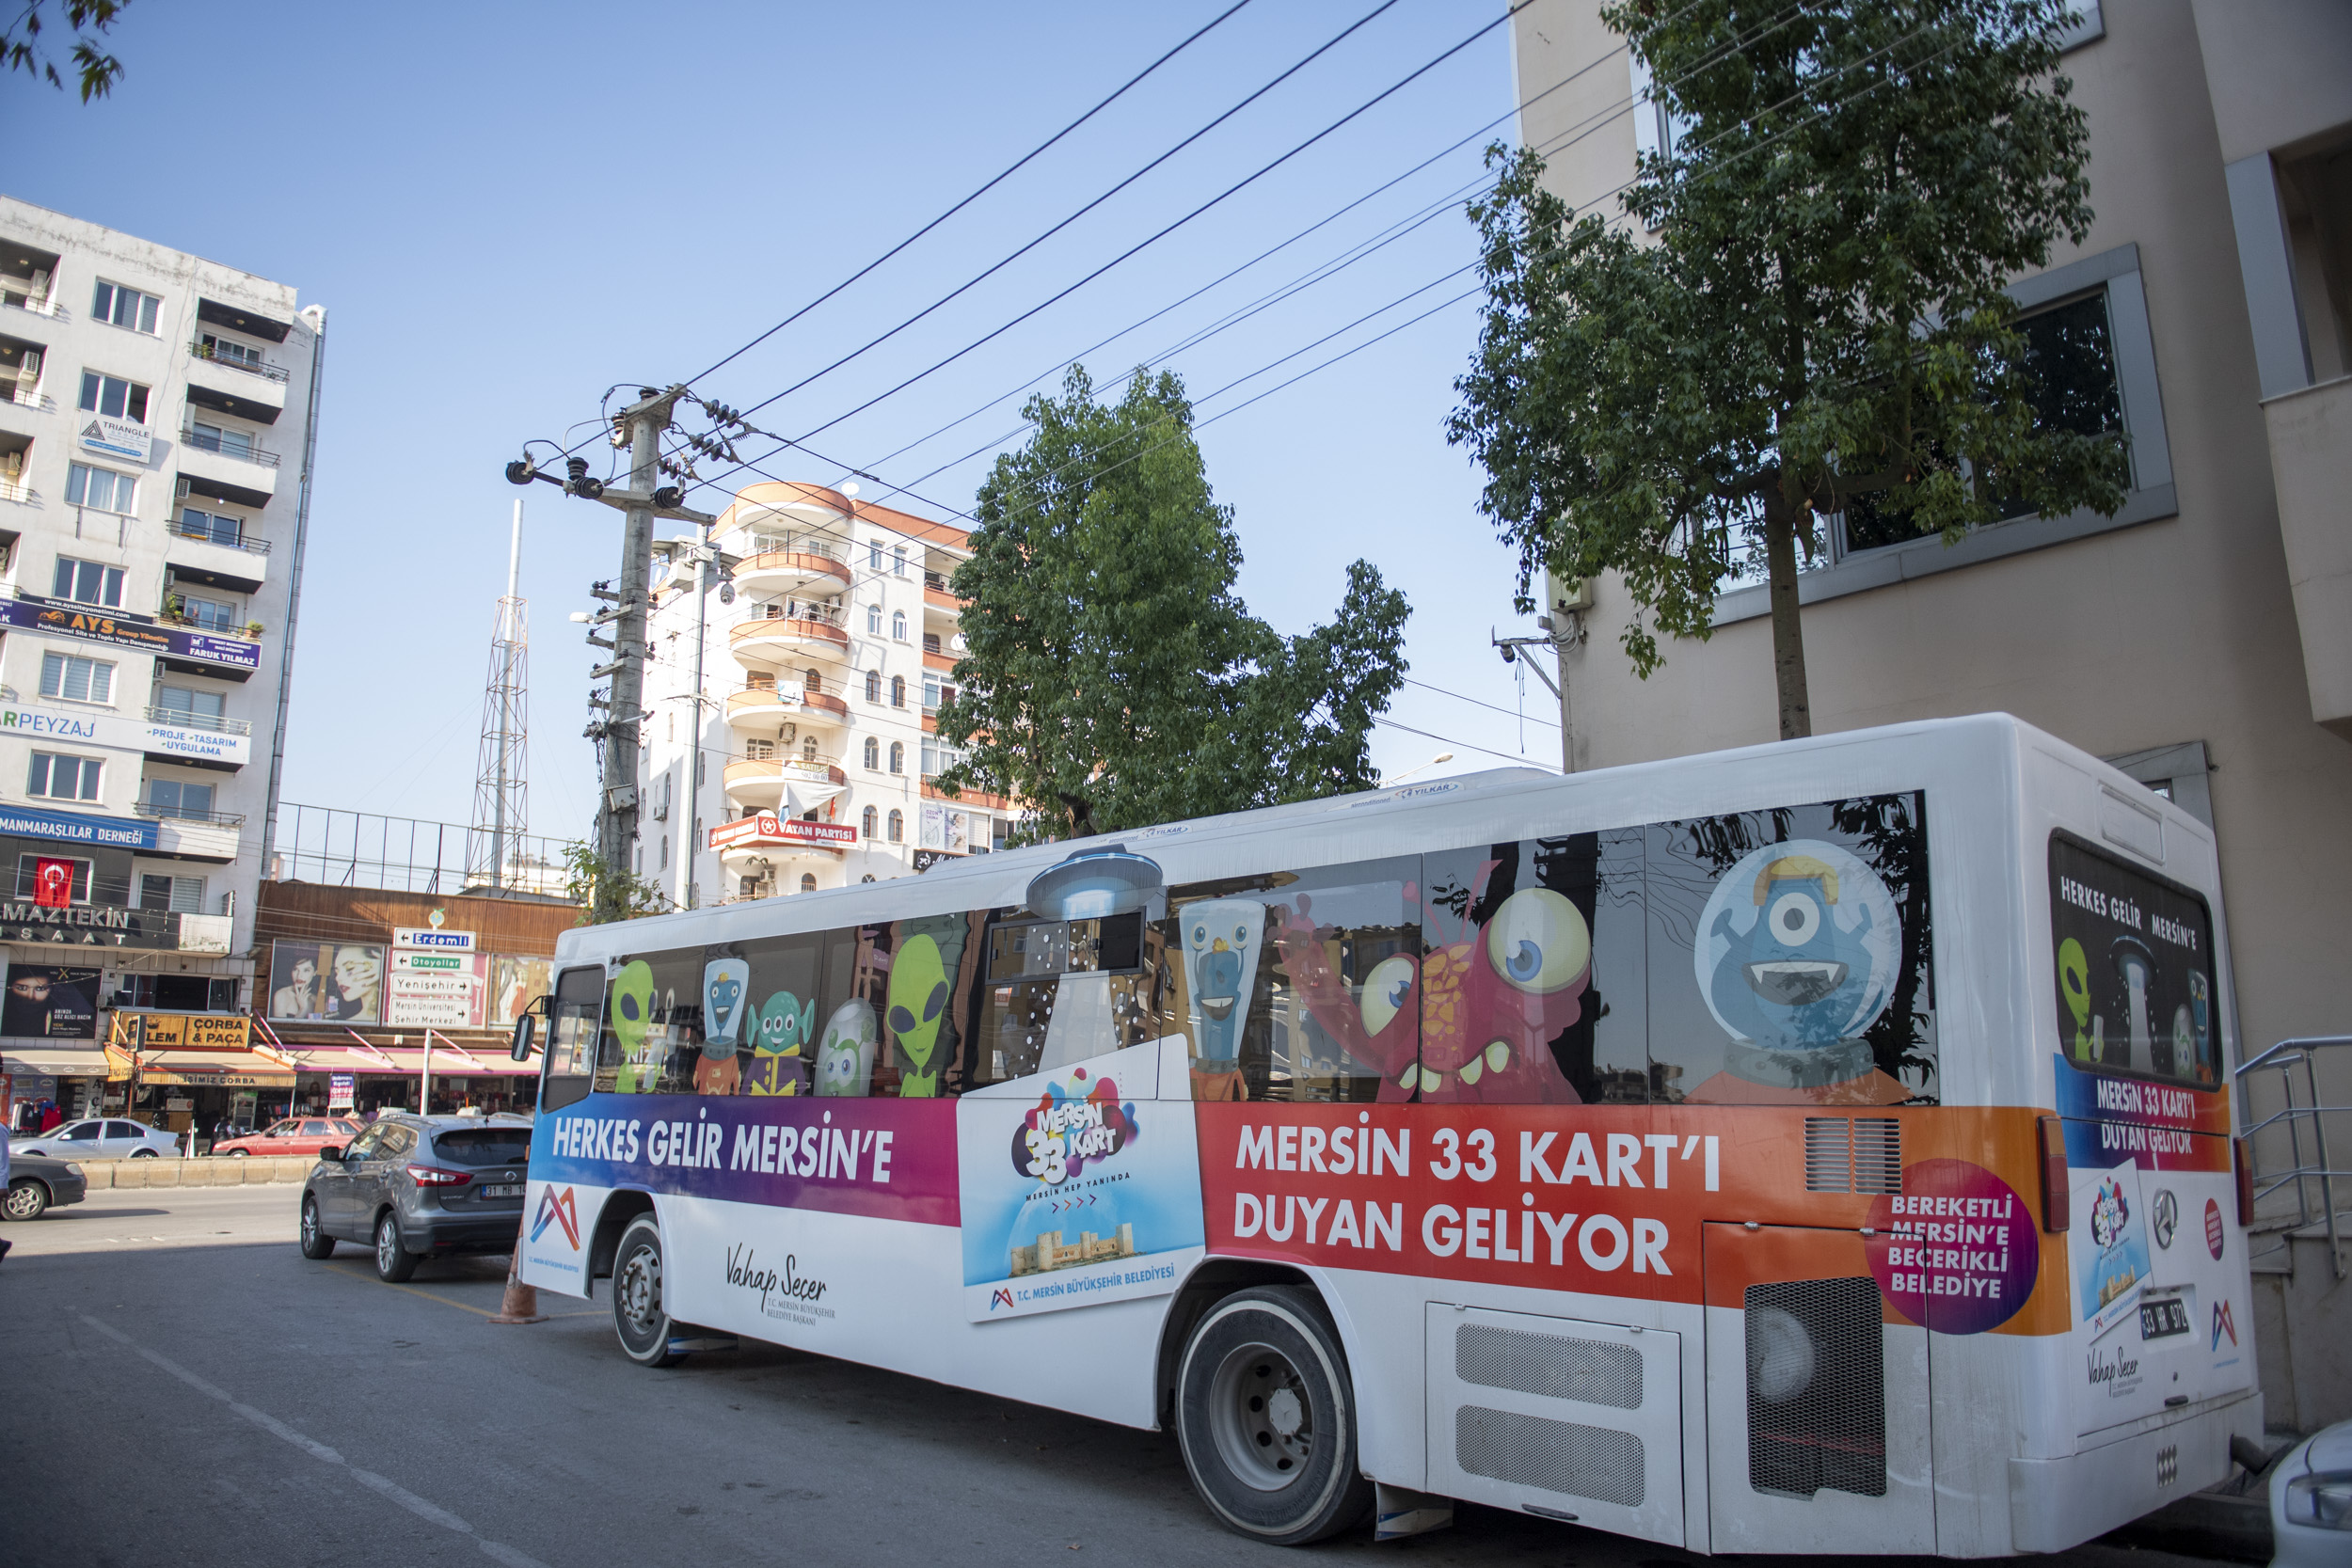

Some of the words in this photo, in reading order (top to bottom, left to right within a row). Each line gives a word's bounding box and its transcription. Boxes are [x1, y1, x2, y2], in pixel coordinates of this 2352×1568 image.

[103, 421, 151, 438] TRIANGLE
[38, 623, 74, 635] Profesyonel
[97, 633, 114, 641] Toplu
[71, 613, 115, 634] AYS
[117, 628, 139, 639] Group
[189, 647, 220, 660] FARUK
[221, 653, 255, 666] YILMAZ
[152, 728, 185, 741] PROJE
[193, 734, 237, 748] TASARIM
[167, 741, 221, 756] UYGULAMA
[1351, 797, 1391, 809] airconditioned
[1415, 784, 1451, 796] YILKAR
[0, 817, 92, 839] MANMARAŞLILAR
[98, 828, 143, 845] DERNEĞİ
[778, 823, 813, 836] VATAN
[815, 828, 852, 841] PARTİSİ
[1156, 827, 1183, 835] YILKAR
[0, 903, 130, 929] MAZTEKİN
[2060, 876, 2107, 917] HERKES
[2110, 897, 2142, 930] GELİR
[2152, 913, 2197, 951] MERSİN'E
[414, 934, 469, 946] Erdemli
[412, 958, 460, 967] Otoyollar
[397, 979, 455, 990] Yenişehir
[395, 1001, 417, 1010] Mersin
[419, 1000, 456, 1011] Üniversitesi
[193, 1019, 243, 1032] ÇORBA
[395, 1015, 419, 1023] Şehir
[421, 1016, 456, 1024] Merkezi
[146, 1033, 177, 1043] LEM
[192, 1033, 202, 1043] &
[206, 1033, 244, 1047] PAÇA
[219, 1077, 256, 1085] ÇORBA
[2097, 1079, 2143, 1114] MERSİN
[2145, 1085, 2159, 1117] 33
[2161, 1088, 2196, 1120] KART'I
[1036, 1095, 1103, 1134] MERSİN
[553, 1117, 641, 1164] HERKES
[647, 1107, 723, 1170] GELİR
[730, 1110, 894, 1183] MERSİN'E
[2101, 1118, 2146, 1151] DUYAN
[2149, 1123, 2192, 1154] GELİYOR
[1025, 1131, 1068, 1184] 33
[1069, 1128, 1117, 1159] KART
[1234, 1110, 1410, 1178] MERSİN
[1429, 1128, 1497, 1182] 33
[1519, 1131, 1720, 1192] KART'I
[486, 1186, 497, 1196] 31
[502, 1185, 513, 1196] MB
[1025, 1187, 1059, 1201] MERSİN
[1064, 1183, 1081, 1193] HEP
[1087, 1172, 1130, 1188] YANINDA
[1891, 1193, 2012, 1219] BEREKETLİ
[1233, 1192, 1403, 1253] DUYAN
[1422, 1192, 1674, 1276] GELİYOR
[1889, 1218, 2010, 1245] MERSİN'E
[1887, 1244, 2009, 1273] BECERİKLİ
[727, 1242, 777, 1313] Vahap
[781, 1254, 827, 1302] Seçer
[1017, 1291, 1031, 1302] T.C.
[1032, 1282, 1065, 1300] MERSİN
[1067, 1272, 1122, 1294] BÜYÜKŞEHİR
[1124, 1262, 1174, 1285] BELEDİYESİ
[1891, 1271, 2002, 1299] BELEDİYE
[767, 1308, 791, 1322] BELEDİYE
[792, 1313, 817, 1326] BAŞKANI
[778, 1299, 799, 1312] MERSİN
[800, 1303, 835, 1319] BÜYÜKŞEHİR
[2142, 1308, 2155, 1334] 33
[2169, 1304, 2187, 1329] 972
[2087, 1347, 2116, 1398] Vahap
[2117, 1345, 2138, 1378] Seçer
